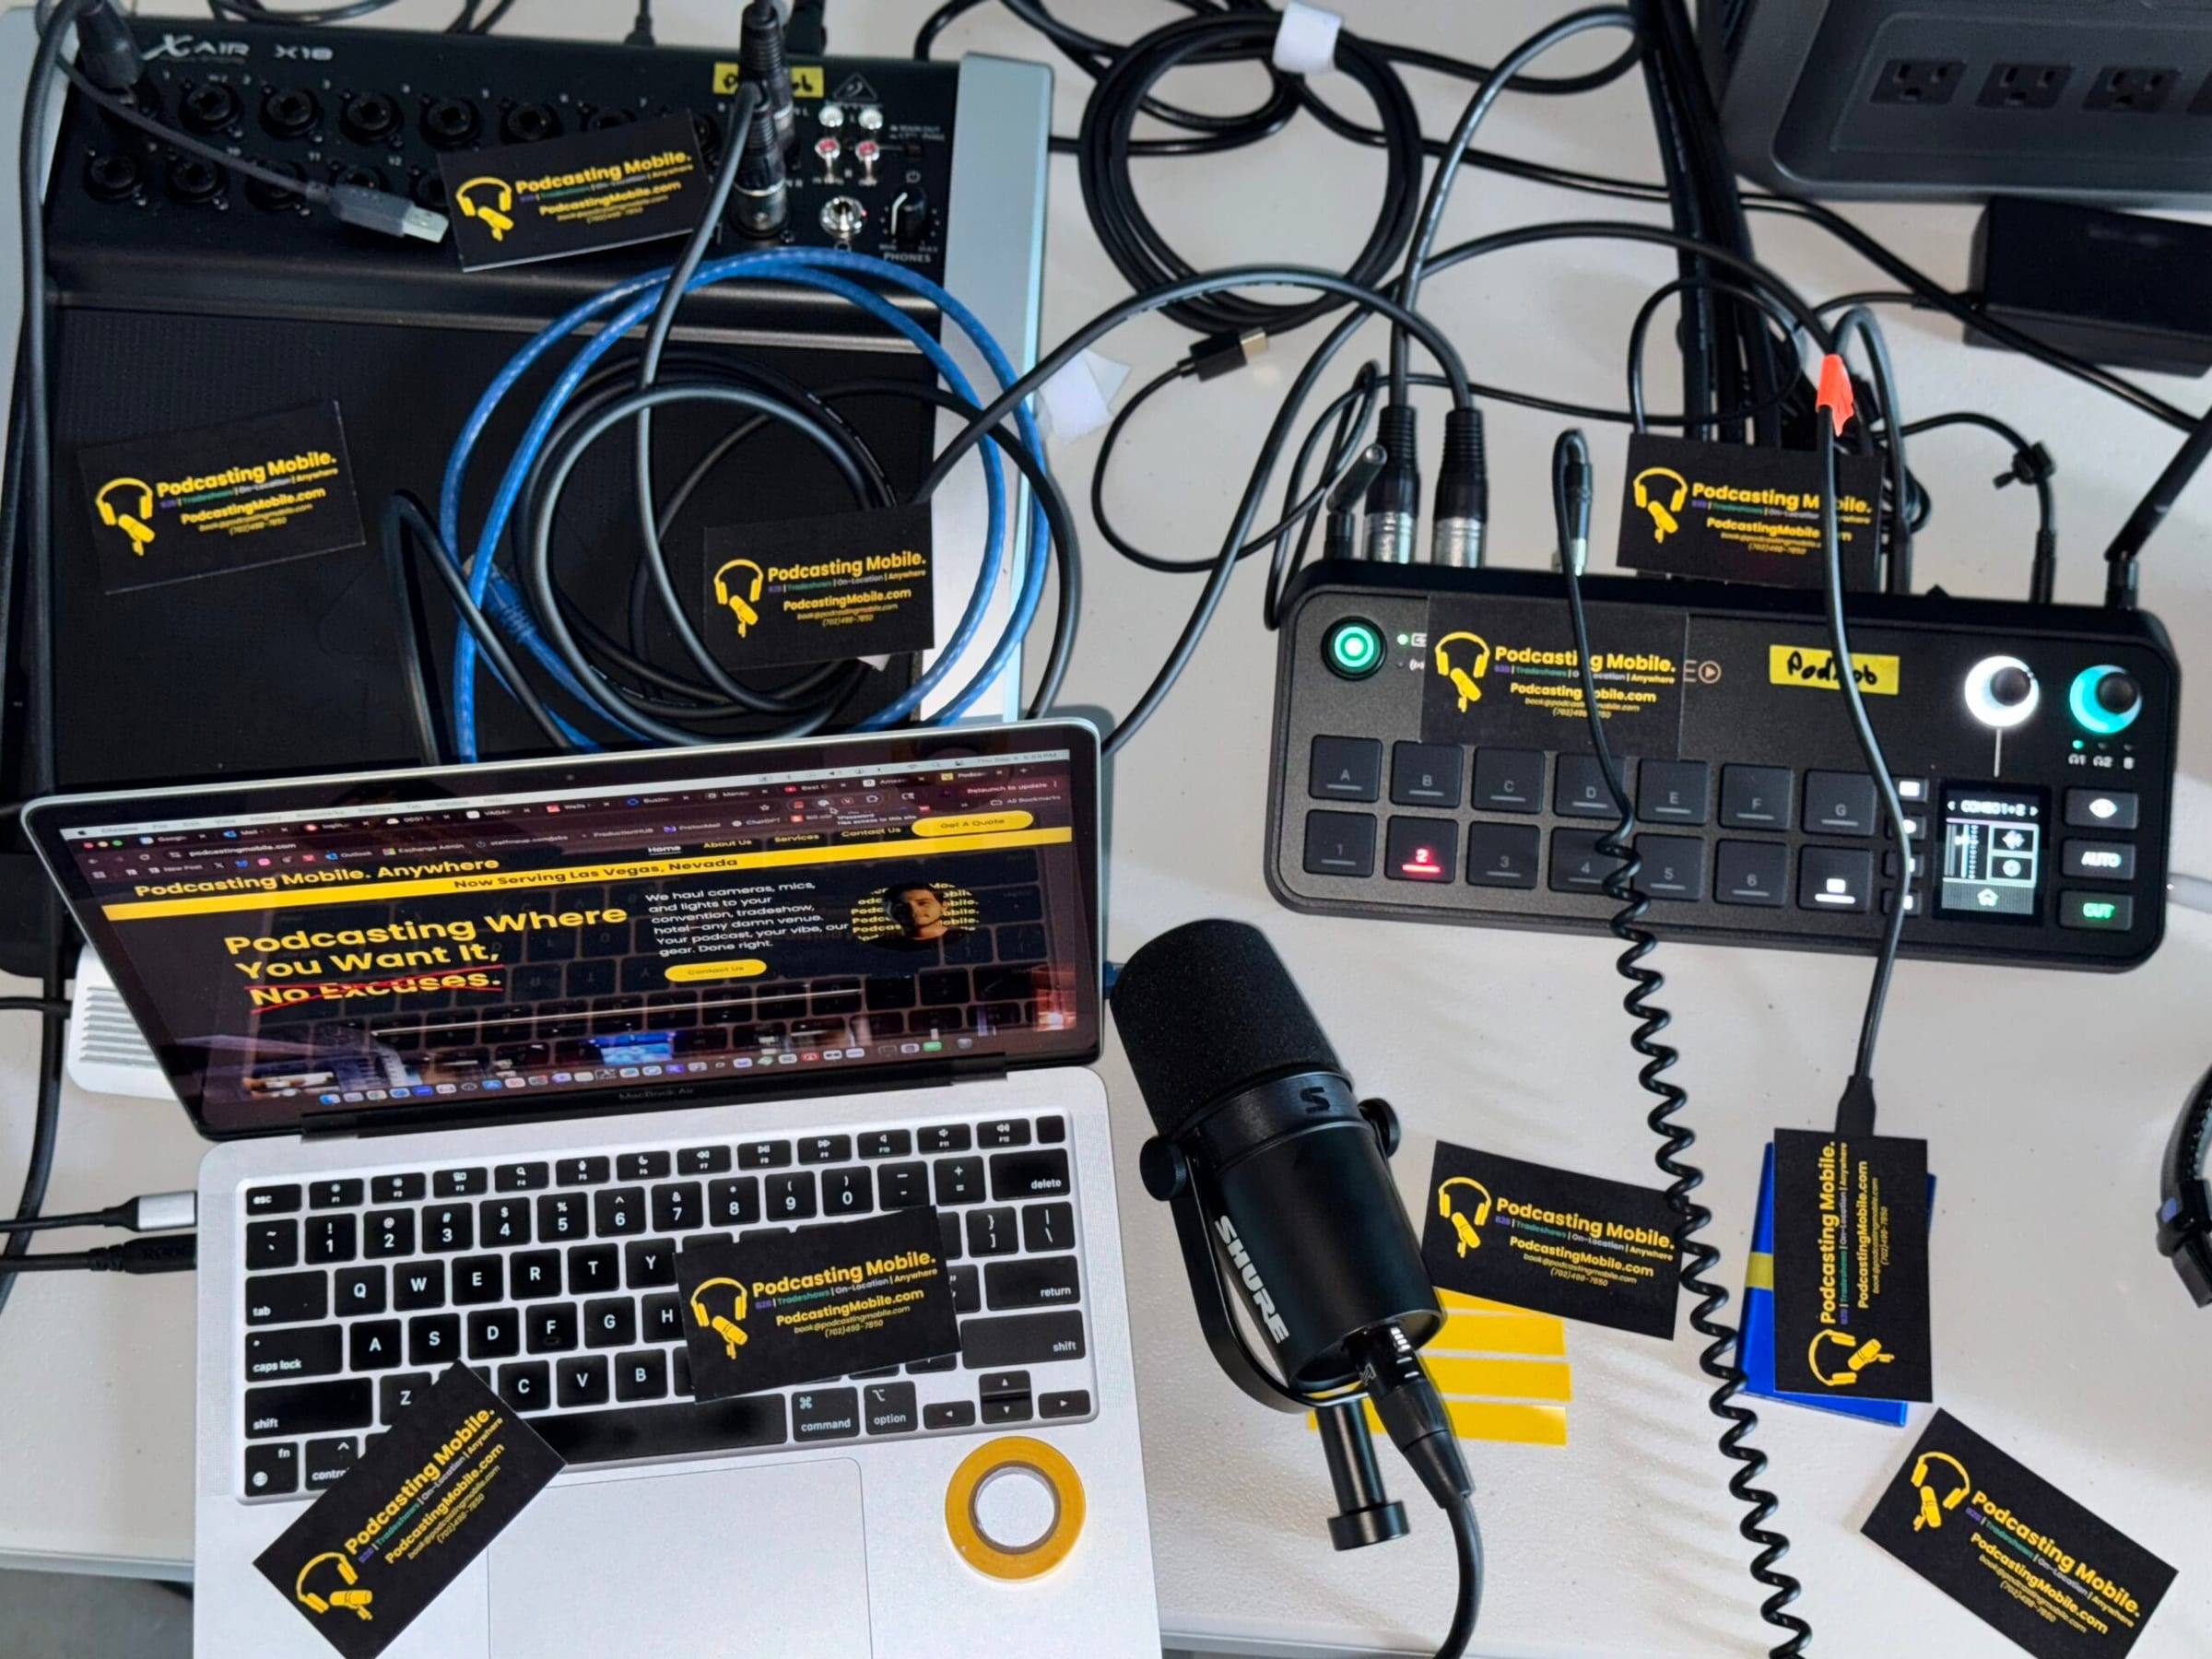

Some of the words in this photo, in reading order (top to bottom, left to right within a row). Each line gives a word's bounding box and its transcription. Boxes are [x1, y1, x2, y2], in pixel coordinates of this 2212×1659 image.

[515, 165, 622, 194] Podcasting
[623, 150, 691, 174] Mobile.
[538, 181, 681, 216] PodcastingMobile.com
[884, 253, 931, 263] PHONES
[157, 465, 265, 498] Podcasting
[267, 451, 337, 477] Mobile.
[296, 467, 338, 484] Anywhere
[181, 488, 326, 524] PodcastingMobile.com
[1691, 482, 1798, 512] Podcasting
[768, 559, 863, 582] Podcasting
[865, 550, 926, 572] Mobile.
[888, 569, 926, 582] Anywhere
[783, 588, 912, 612] PodcastingMobile.com
[1495, 646, 1603, 672] Podcastig
[1606, 653, 1677, 673] Mobile.
[1787, 651, 1877, 685] Podob
[1510, 682, 1656, 703] Podcastingobile.com
[1630, 674, 1676, 685] Anywhere
[2068, 753, 2086, 766] A1
[2092, 755, 2113, 768] A2
[1340, 769, 1350, 782] A
[1422, 775, 1432, 787] B
[1503, 780, 1514, 793] C
[1586, 786, 1596, 799] D
[1670, 792, 1678, 805] E
[1753, 797, 1761, 810] F
[1835, 804, 1847, 817] G
[940, 821, 959, 830] Get
[972, 818, 1005, 827] Quote
[189, 842, 296, 857] podcastingmobile.com
[648, 845, 681, 853] Home
[703, 839, 736, 849] About
[774, 833, 819, 842] Services
[841, 828, 885, 838] Contact
[453, 877, 493, 889] Now
[497, 870, 566, 887] Serving
[570, 870, 599, 880] Las
[601, 863, 665, 878] Vegas,
[669, 858, 738, 871] Nevada
[1337, 843, 1343, 856] 1
[1416, 848, 1429, 863] 2
[1500, 855, 1509, 867] 3
[1581, 861, 1591, 874] 4
[1665, 867, 1674, 880] 5
[1747, 874, 1757, 886] 6
[2081, 852, 2121, 867] AUTO
[135, 874, 276, 897] Podcasting
[283, 867, 371, 885] Mobile.
[378, 859, 500, 878] Anywhere
[645, 893, 669, 902] We
[672, 890, 704, 900] haul
[707, 884, 776, 898] cameras,
[778, 881, 816, 892] mics,
[648, 903, 677, 913] and
[680, 900, 719, 912] lights
[722, 899, 737, 907] to
[740, 896, 771, 907] your
[652, 910, 735, 924] convention,
[736, 903, 815, 917] tradeshow,
[2083, 902, 2115, 918] CUT
[224, 920, 477, 955] Podcasting
[484, 908, 628, 934] Where
[656, 936, 688, 946] Your
[691, 931, 754, 946] podcast,
[755, 928, 786, 939] your
[790, 924, 822, 935] vibe,
[825, 922, 850, 932] our
[731, 918, 774, 929] damn
[777, 914, 824, 924] venue.
[235, 959, 323, 980] You
[329, 946, 451, 972] Want
[458, 942, 500, 962] It,
[659, 947, 696, 958] gear.
[698, 943, 735, 953] Done
[738, 940, 774, 951] right.
[688, 966, 729, 976] Contact
[250, 987, 310, 1006] No
[318, 972, 501, 1000] Excuses.
[1818, 1140, 1836, 1211] Mobile.
[1839, 1142, 1850, 1188] Anywhere
[1030, 1178, 1062, 1190] delete
[253, 1195, 272, 1206] esc
[326, 1239, 334, 1253] 1
[383, 1234, 394, 1248] 2
[442, 1229, 453, 1242] 3
[500, 1223, 511, 1237] 4
[558, 1218, 568, 1231] 5
[615, 1212, 626, 1227] 6
[672, 1207, 682, 1222] 7
[729, 1202, 739, 1216] 8
[785, 1196, 796, 1210] 9
[842, 1192, 853, 1206] 0
[1497, 1197, 1603, 1237] Podcasting
[1606, 1221, 1675, 1250] Mobile.
[1855, 1160, 1871, 1309] PodcastingMobile.com
[1510, 1235, 1654, 1277] PodcastingMobile.com
[1515, 1220, 1567, 1239] Tradeshows
[1571, 1232, 1625, 1252] On-Location
[1630, 1245, 1673, 1262] Anywhere
[354, 1283, 366, 1298] Q
[410, 1277, 427, 1291] W
[472, 1272, 482, 1286] E
[530, 1267, 541, 1281] R
[588, 1261, 599, 1276] T
[645, 1255, 656, 1270] Y
[752, 1264, 864, 1298] Podcasting
[865, 1251, 936, 1277] Mobile.
[1215, 1215, 1289, 1344] SHURE
[1818, 1214, 1841, 1325] Podcasting
[777, 1289, 830, 1306] Tradeshows
[835, 1277, 889, 1295] On-Location
[893, 1267, 938, 1284] Anywhere
[1041, 1286, 1071, 1298] return
[253, 1306, 271, 1317] tab
[776, 1288, 924, 1327] PodcastingMobile.com
[370, 1338, 382, 1352] A
[429, 1332, 441, 1347] S
[488, 1326, 499, 1340] D
[547, 1320, 557, 1335] F
[604, 1314, 616, 1329] G
[662, 1309, 674, 1324] H
[1053, 1340, 1077, 1353] shift
[253, 1362, 278, 1374] caps
[279, 1359, 302, 1371] lock
[400, 1391, 412, 1406] Z
[518, 1379, 530, 1394] C
[576, 1373, 589, 1387] V
[635, 1368, 647, 1382] B
[253, 1418, 278, 1430] shift
[801, 1418, 851, 1432] command
[873, 1413, 907, 1427] option
[278, 1448, 290, 1458] fn
[420, 1455, 465, 1501] On-Location
[466, 1418, 503, 1455] Anywhere
[344, 1462, 441, 1555] Podcasting
[433, 1407, 496, 1466] Mobile.
[384, 1442, 505, 1564] PodcastingMobile.com
[1971, 1490, 2076, 1574] Podcasting
[2075, 1562, 2141, 1618] Mobile.
[1971, 1532, 2108, 1634] PodcastingMobile.com
[2090, 1594, 2135, 1629] Anywhere
